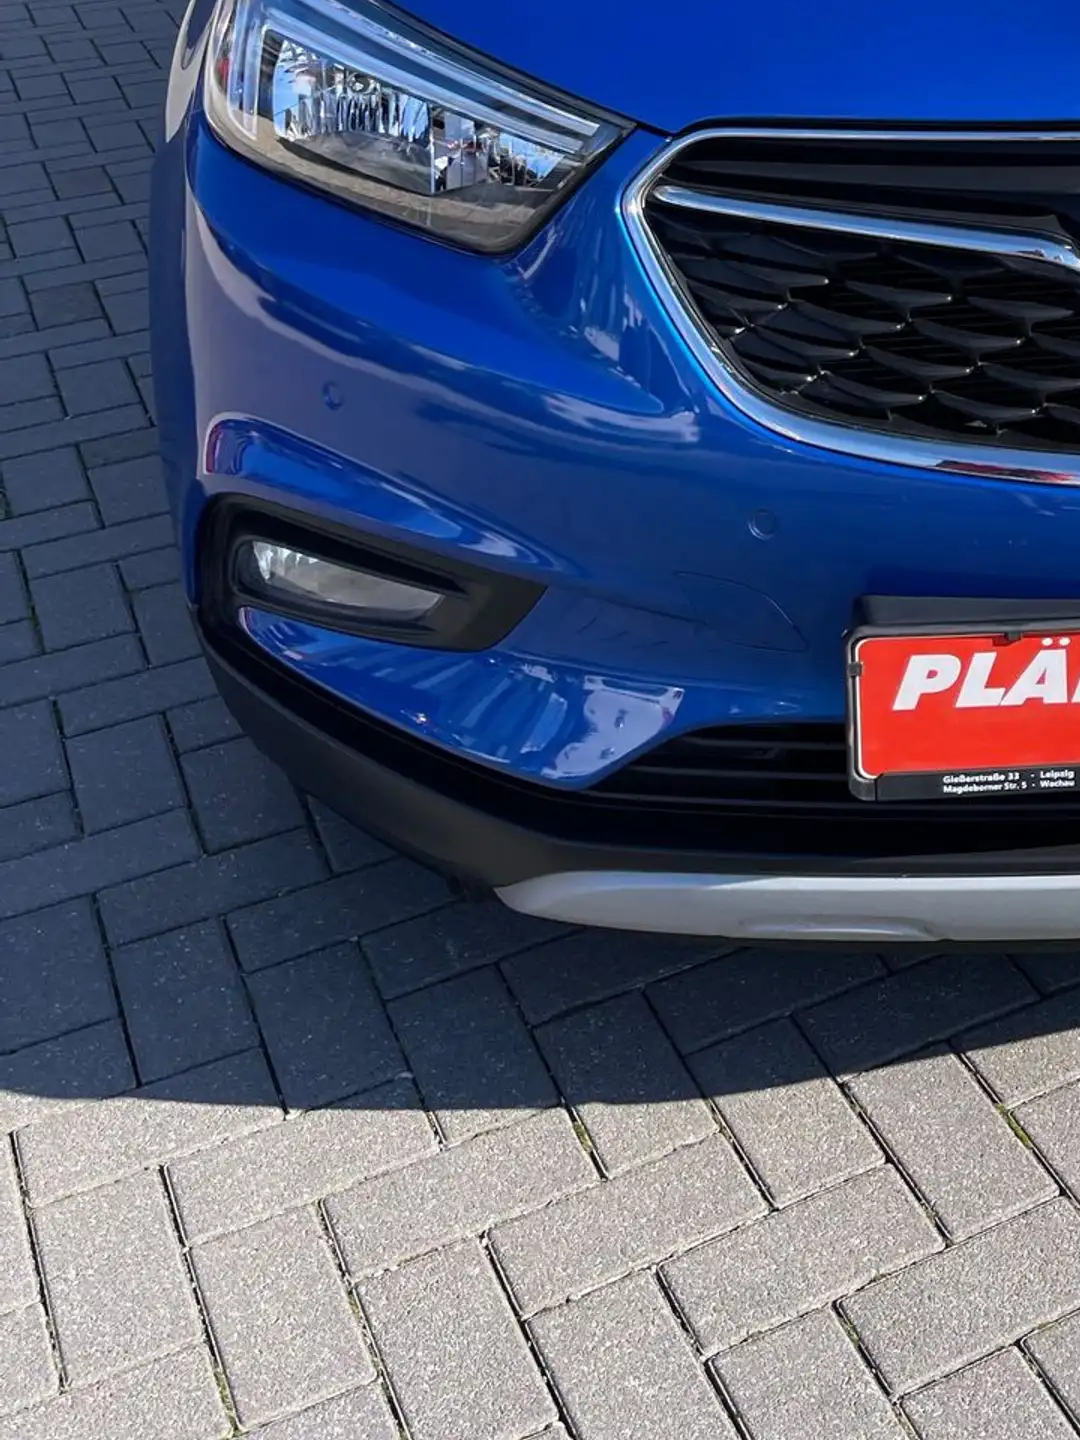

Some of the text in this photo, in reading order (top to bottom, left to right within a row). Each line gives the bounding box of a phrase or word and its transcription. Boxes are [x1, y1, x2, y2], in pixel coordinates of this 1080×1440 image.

[1007, 772, 1020, 781] 33
[1040, 770, 1075, 780] Leipzig
[1040, 778, 1075, 788] Wachau
